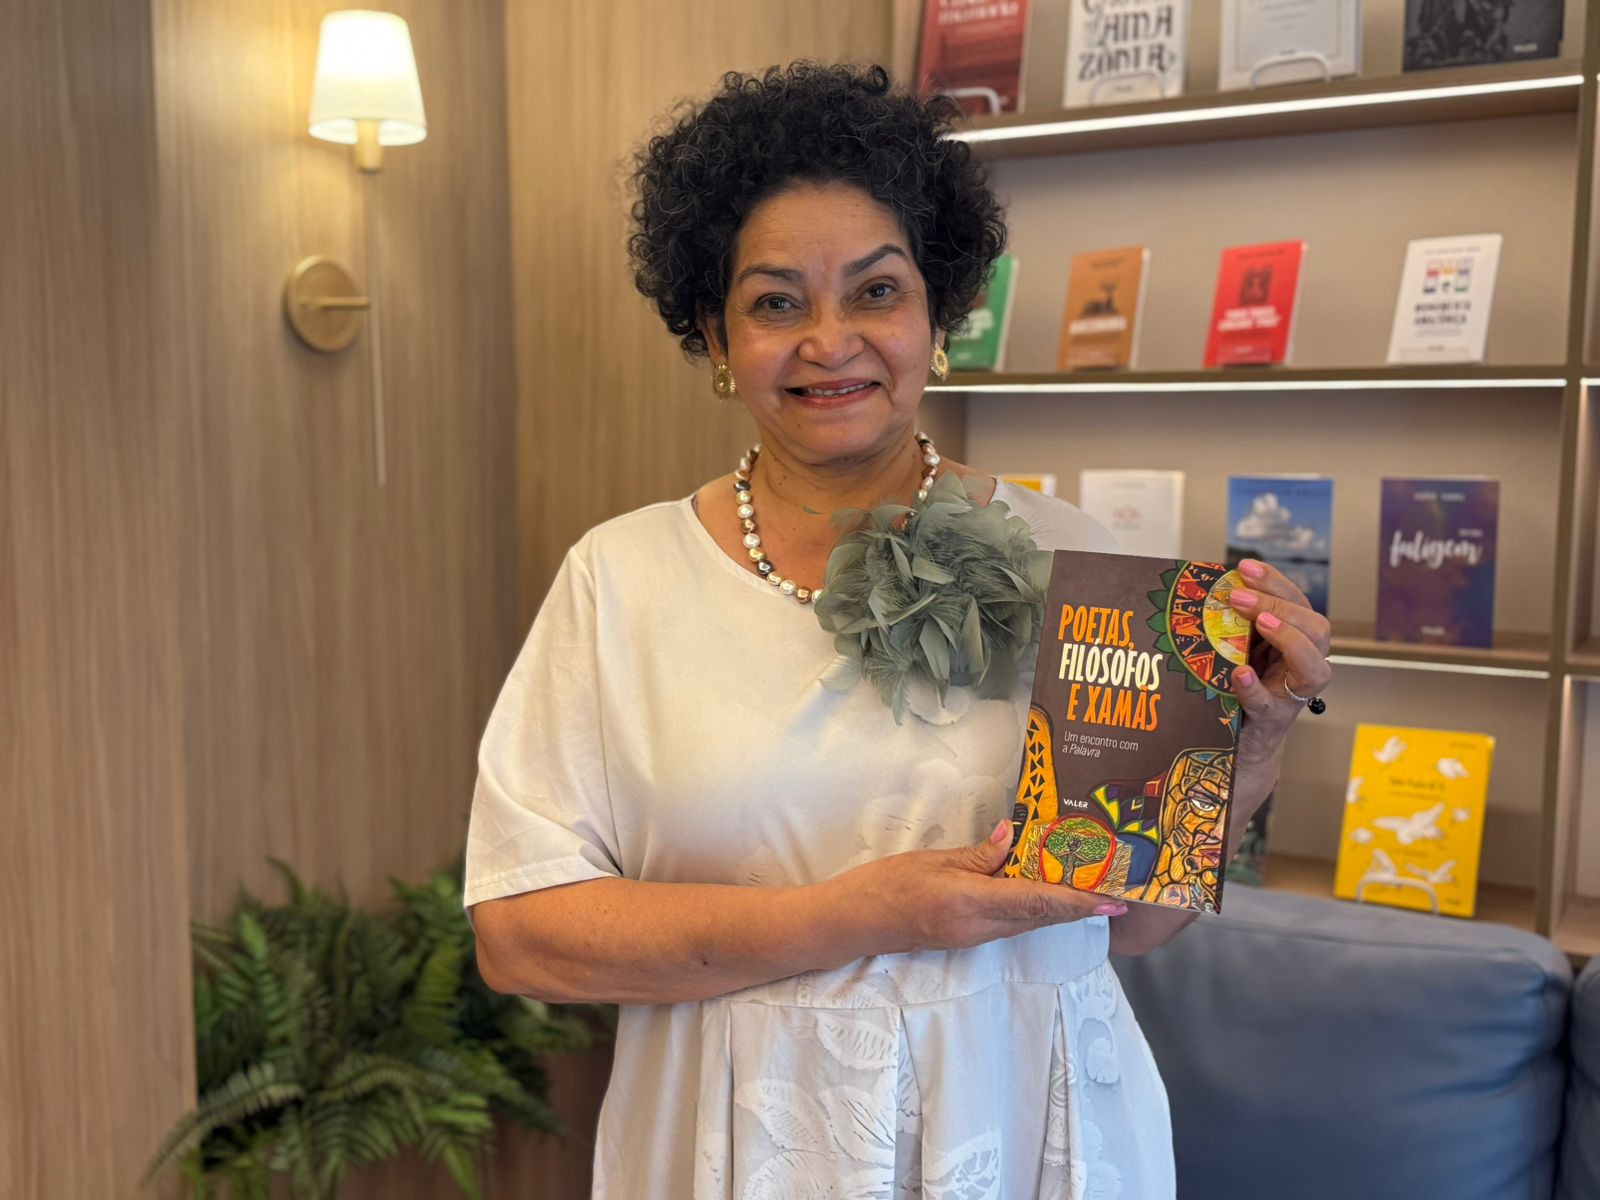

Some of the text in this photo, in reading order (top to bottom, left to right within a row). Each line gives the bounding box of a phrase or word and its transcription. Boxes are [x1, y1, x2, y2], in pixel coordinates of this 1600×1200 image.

[1057, 603, 1135, 652] POETAS,
[1058, 637, 1164, 692] FILÓSOFOS
[1066, 683, 1162, 732] E XAMÃS
[1062, 743, 1101, 758] a Palavra
[1064, 730, 1139, 752] Um encontro com
[1063, 798, 1089, 809] VALER
